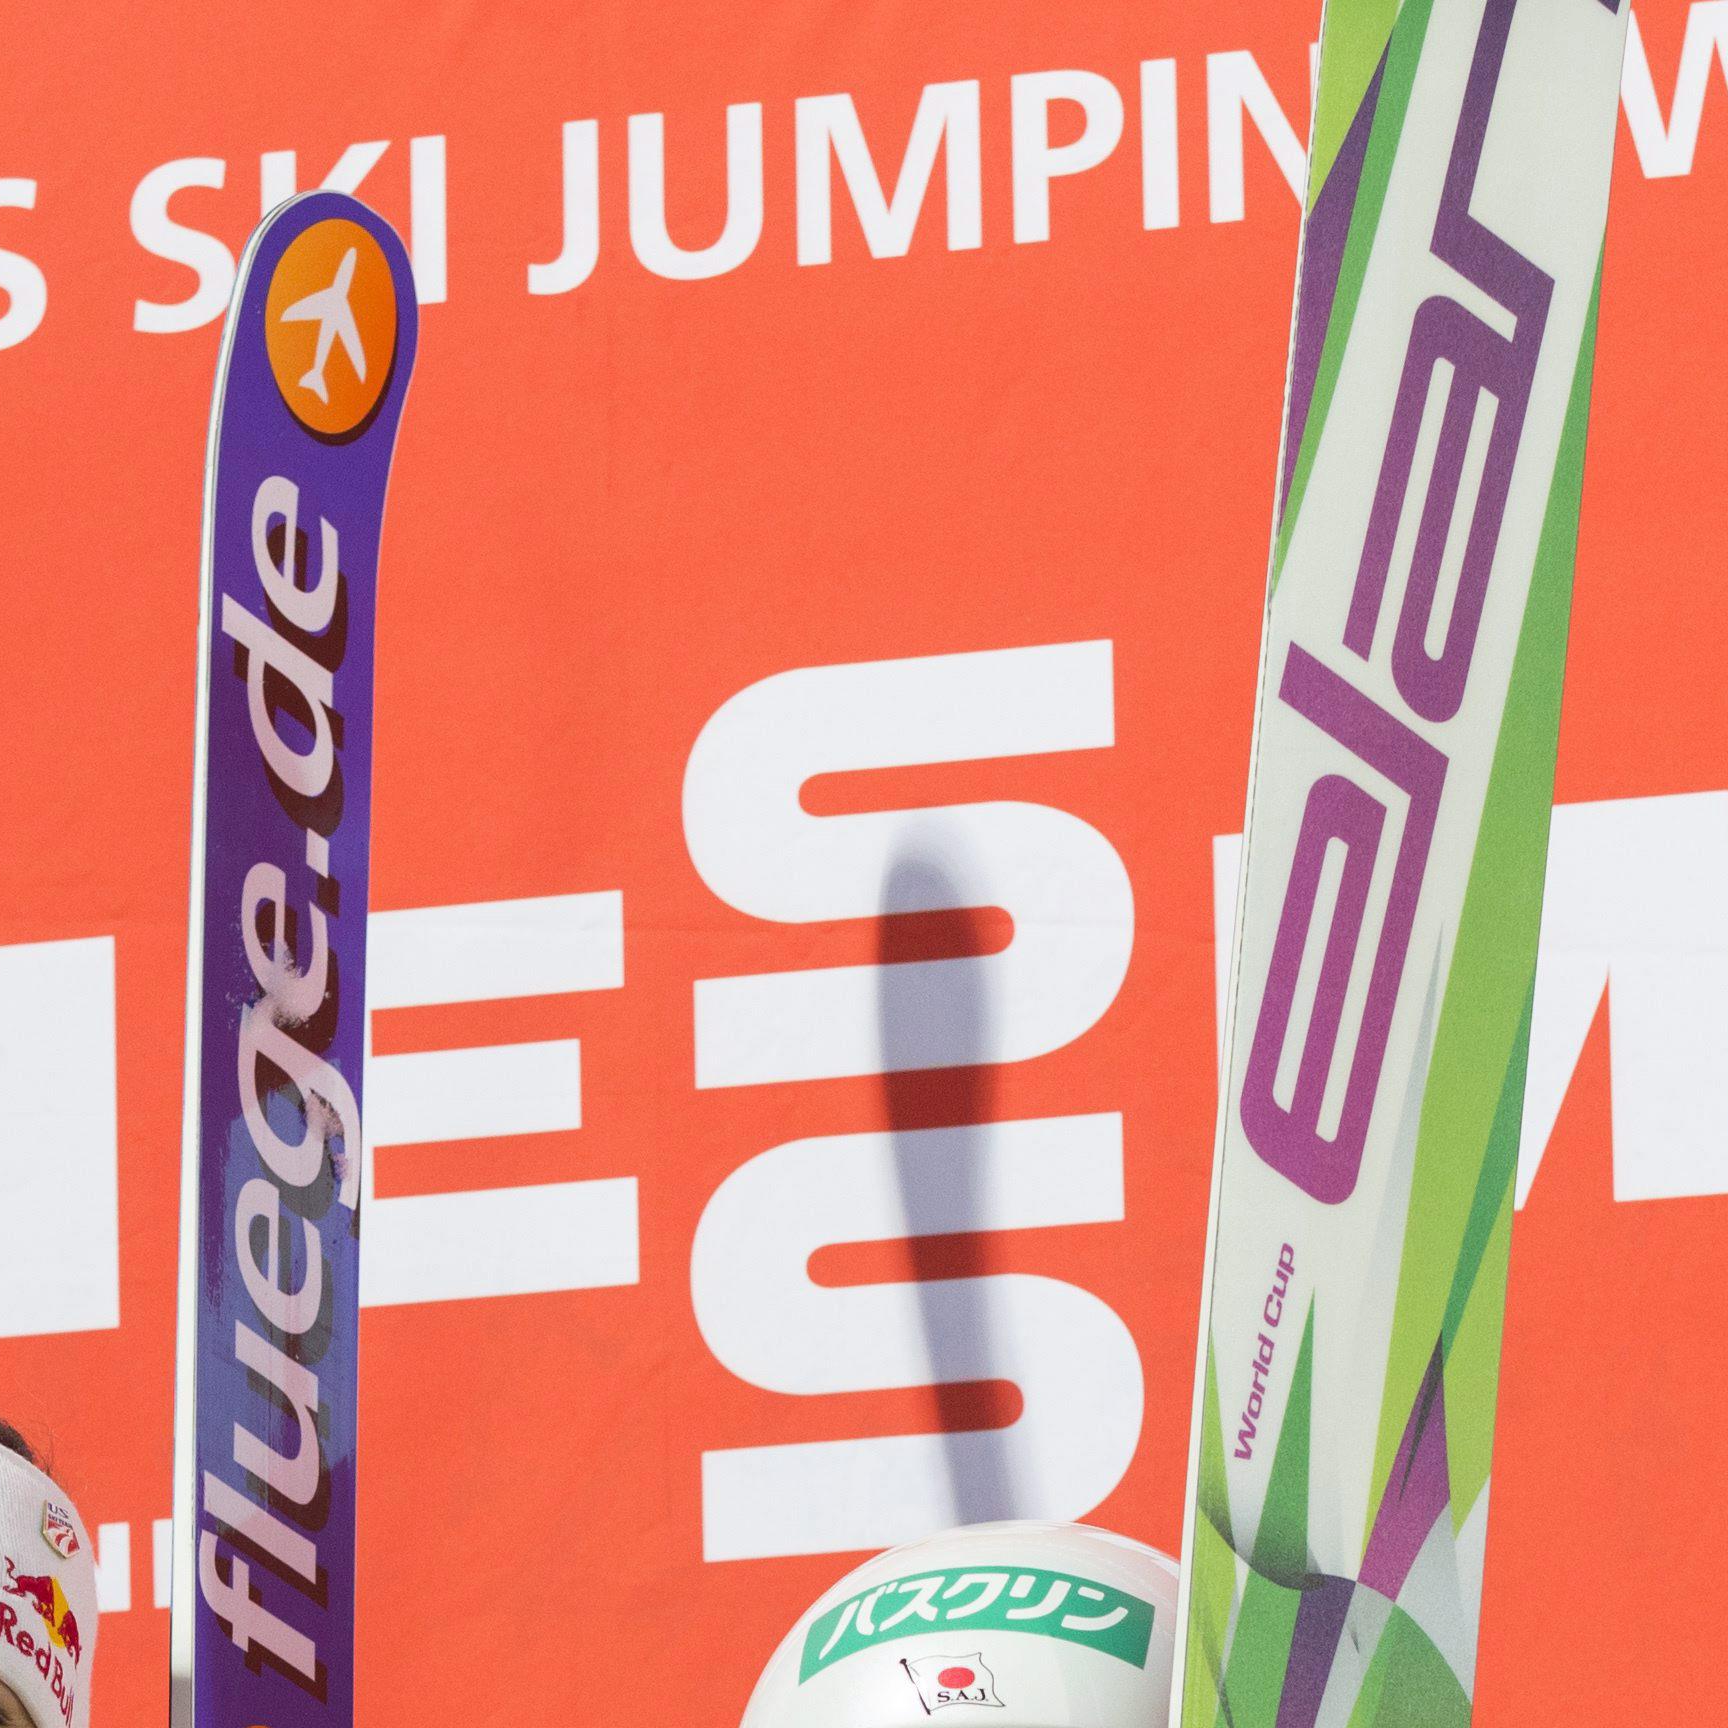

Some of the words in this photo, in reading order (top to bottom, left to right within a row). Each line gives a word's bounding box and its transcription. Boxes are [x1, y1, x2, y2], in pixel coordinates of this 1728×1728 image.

[527, 49, 1319, 296] JUMPIN
[199, 474, 364, 1687] fluege.de
[1234, 1333, 1276, 1461] World
[1263, 1242, 1295, 1328] Cup
[818, 1572, 1129, 1661] バスクリン
